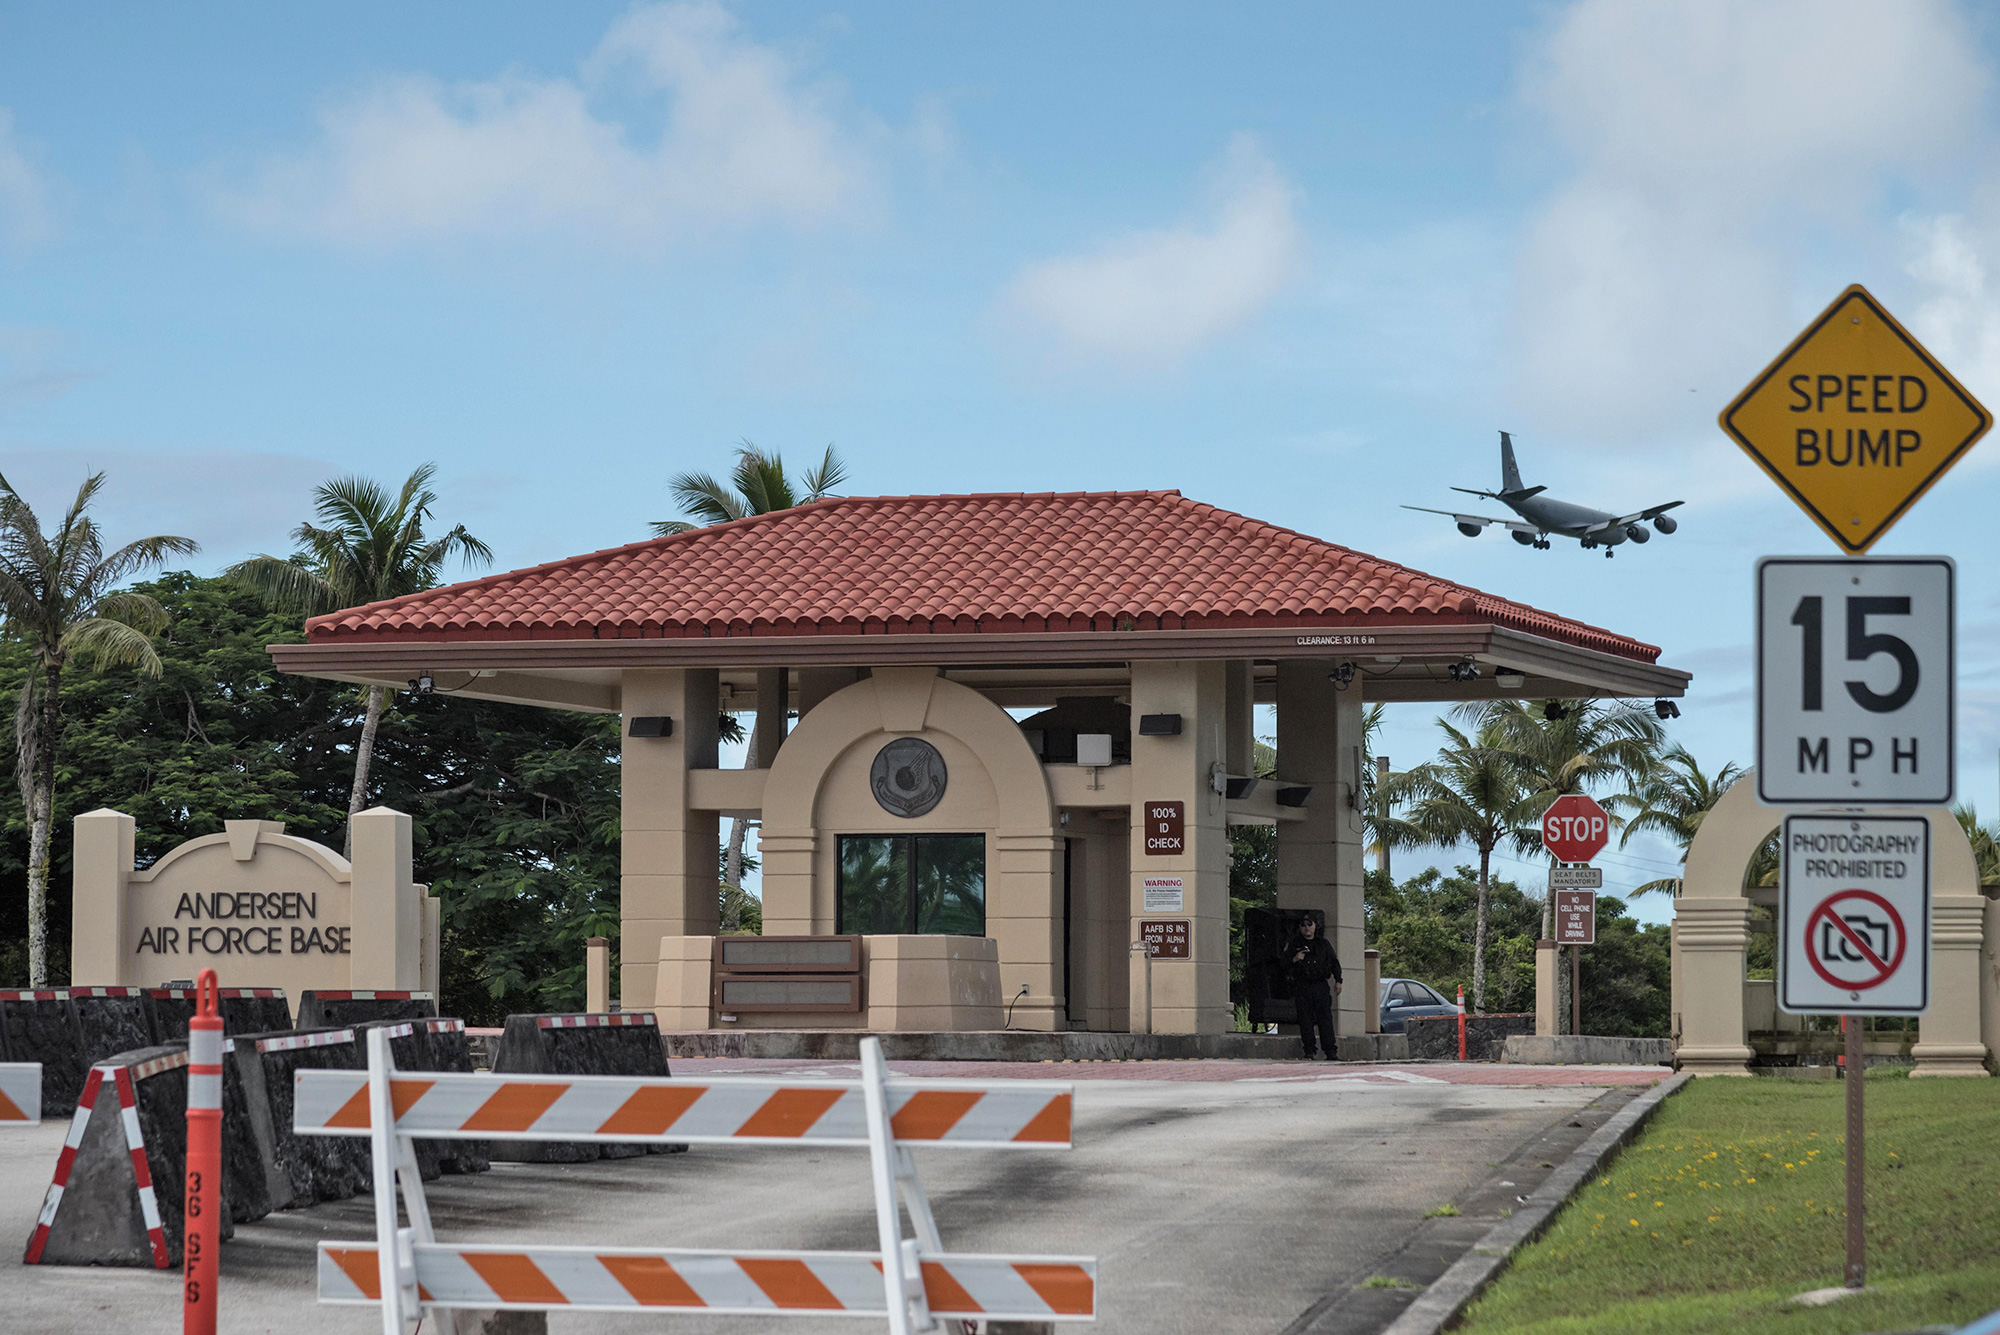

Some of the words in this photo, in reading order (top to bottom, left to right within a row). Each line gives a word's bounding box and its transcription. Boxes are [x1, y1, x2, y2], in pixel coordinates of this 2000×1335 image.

[1788, 374, 1928, 413] SPEED
[1795, 428, 1922, 467] BUMP
[1296, 636, 1342, 645] CLEARANCE:
[1343, 636, 1352, 644] 13
[1353, 636, 1359, 644] ft
[1361, 635, 1367, 644] 6
[1368, 636, 1375, 644] in
[1790, 596, 1920, 714] 15
[1797, 737, 1919, 775] MPH
[1151, 807, 1177, 819] 100%
[1159, 823, 1169, 833] ID
[1547, 816, 1604, 842] STOP
[1147, 838, 1181, 849] CHECK
[1793, 834, 1920, 854] PHOTOGRAPHY
[1805, 859, 1907, 878] PROHIBITED
[1144, 879, 1182, 887] WARNING
[174, 892, 316, 919] ANDERSEN
[1571, 896, 1580, 904] NO
[1569, 913, 1580, 921] USE
[1145, 924, 1164, 933] AAFB
[1166, 925, 1174, 933] IS
[1175, 924, 1186, 933] IN:
[1565, 930, 1585, 938] DRIVING
[136, 927, 179, 954] AIR
[188, 926, 282, 954] FORCE
[291, 926, 351, 954] BASE
[1167, 935, 1185, 944] ALPHA
[1172, 946, 1178, 954] 4
[188, 1171, 202, 1218] 36
[187, 1232, 202, 1304] SFS
